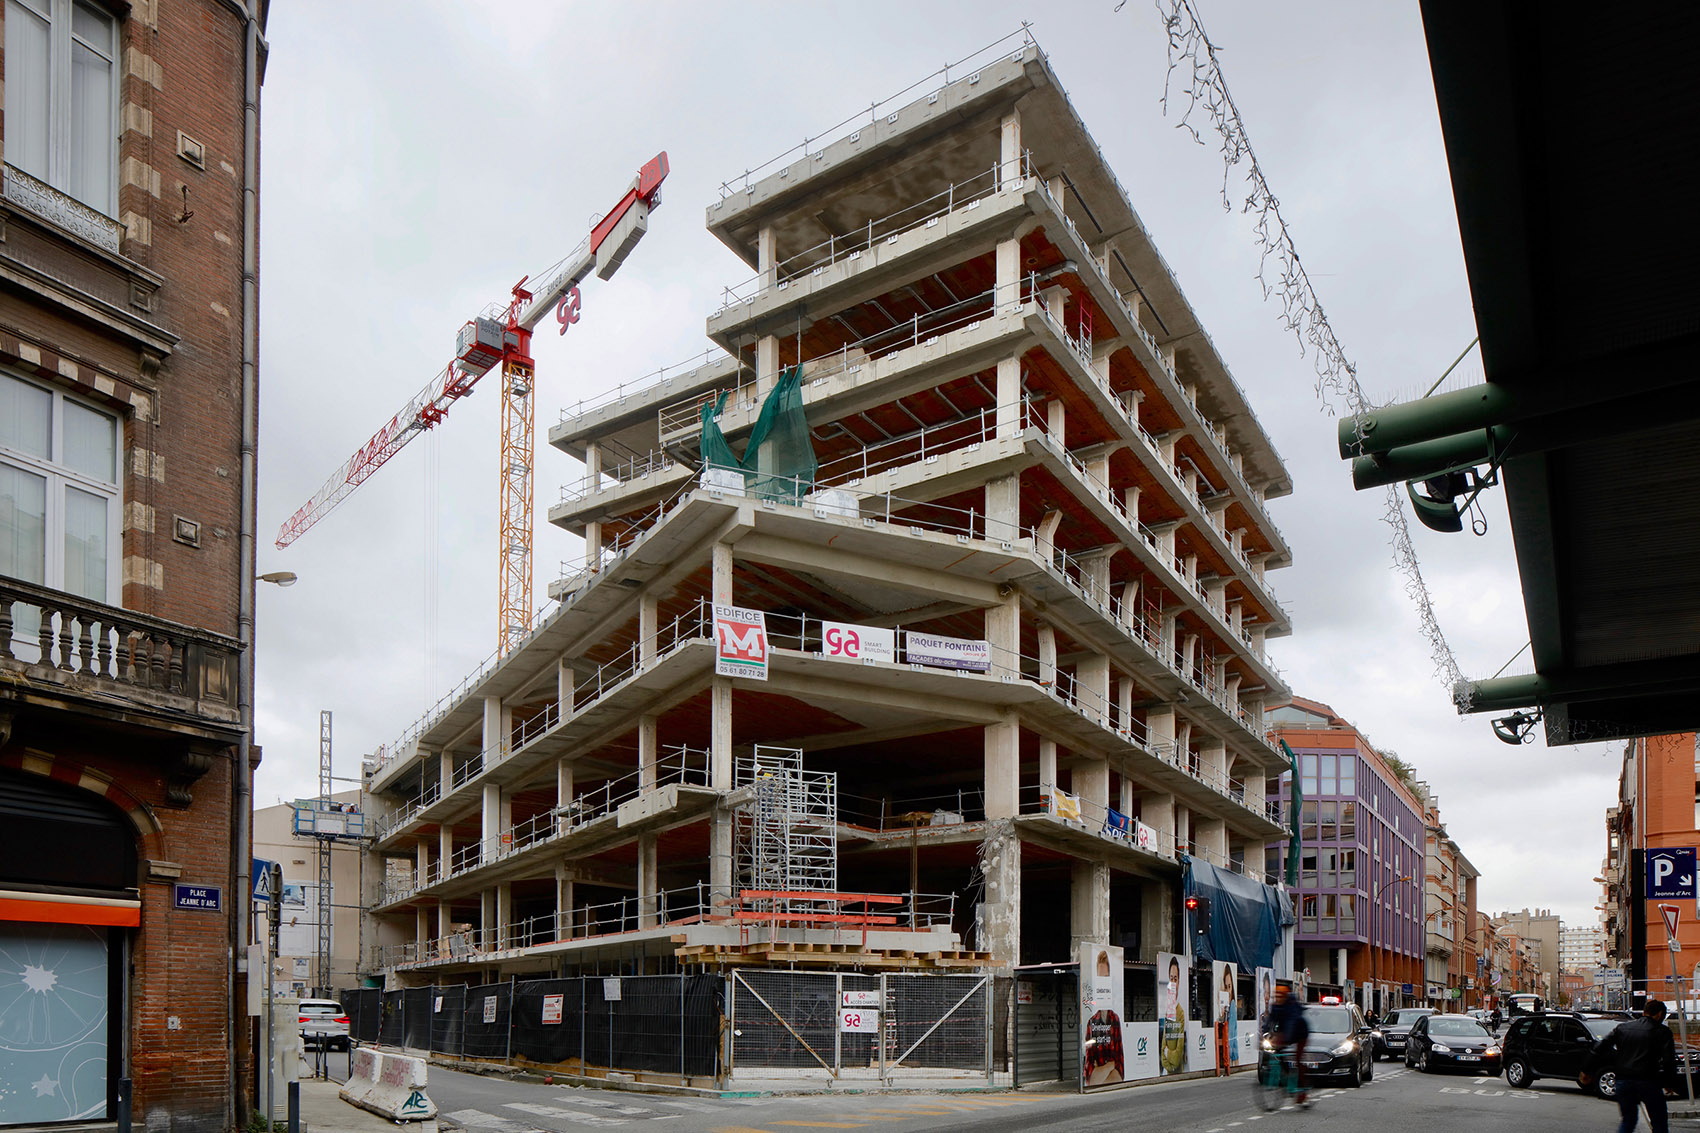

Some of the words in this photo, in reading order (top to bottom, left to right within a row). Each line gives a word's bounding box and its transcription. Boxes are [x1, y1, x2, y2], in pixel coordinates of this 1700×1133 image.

[715, 606, 760, 621] EDIFICE
[718, 622, 763, 658] M
[910, 636, 943, 648] PAQUET
[944, 642, 987, 652] FONTAINE
[864, 647, 891, 655] BUILDING
[909, 655, 933, 664] FAÇADES
[756, 670, 764, 678] 28
[1654, 859, 1674, 887] P
[190, 889, 206, 897] PLACE
[180, 898, 199, 906] JEANNE
[201, 899, 216, 907] D'ARC
[1438, 1087, 1541, 1099] BUS
